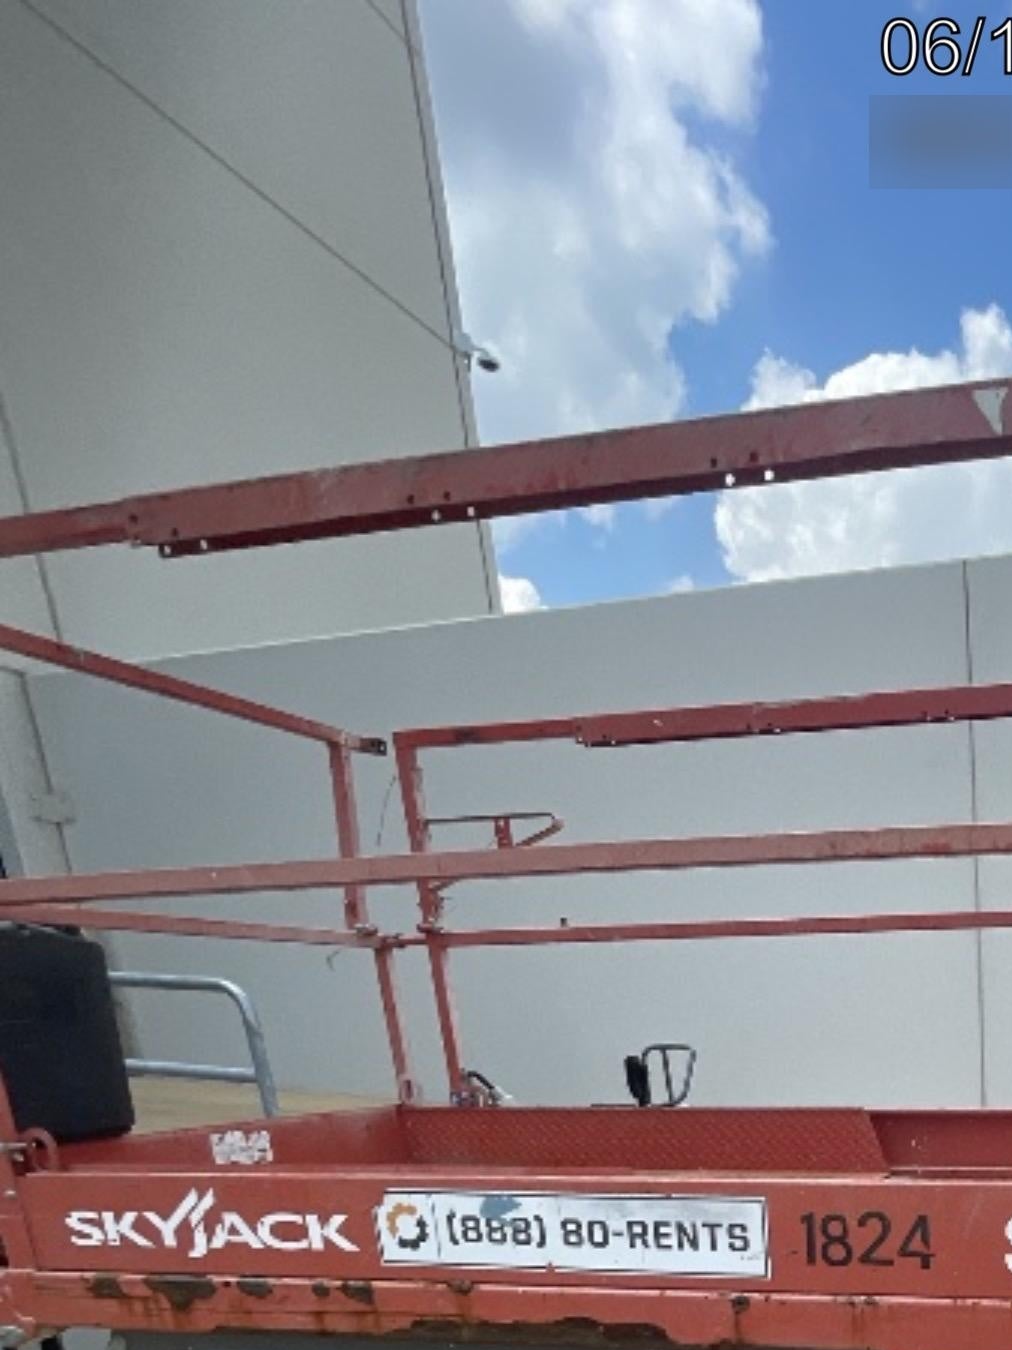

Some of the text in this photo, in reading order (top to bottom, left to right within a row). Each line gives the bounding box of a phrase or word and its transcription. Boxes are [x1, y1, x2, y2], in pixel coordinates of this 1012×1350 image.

[65, 1187, 361, 1258] SKYJACK
[446, 1212, 751, 1253] (888) 80-RENTS
[800, 1211, 936, 1270] 1824
